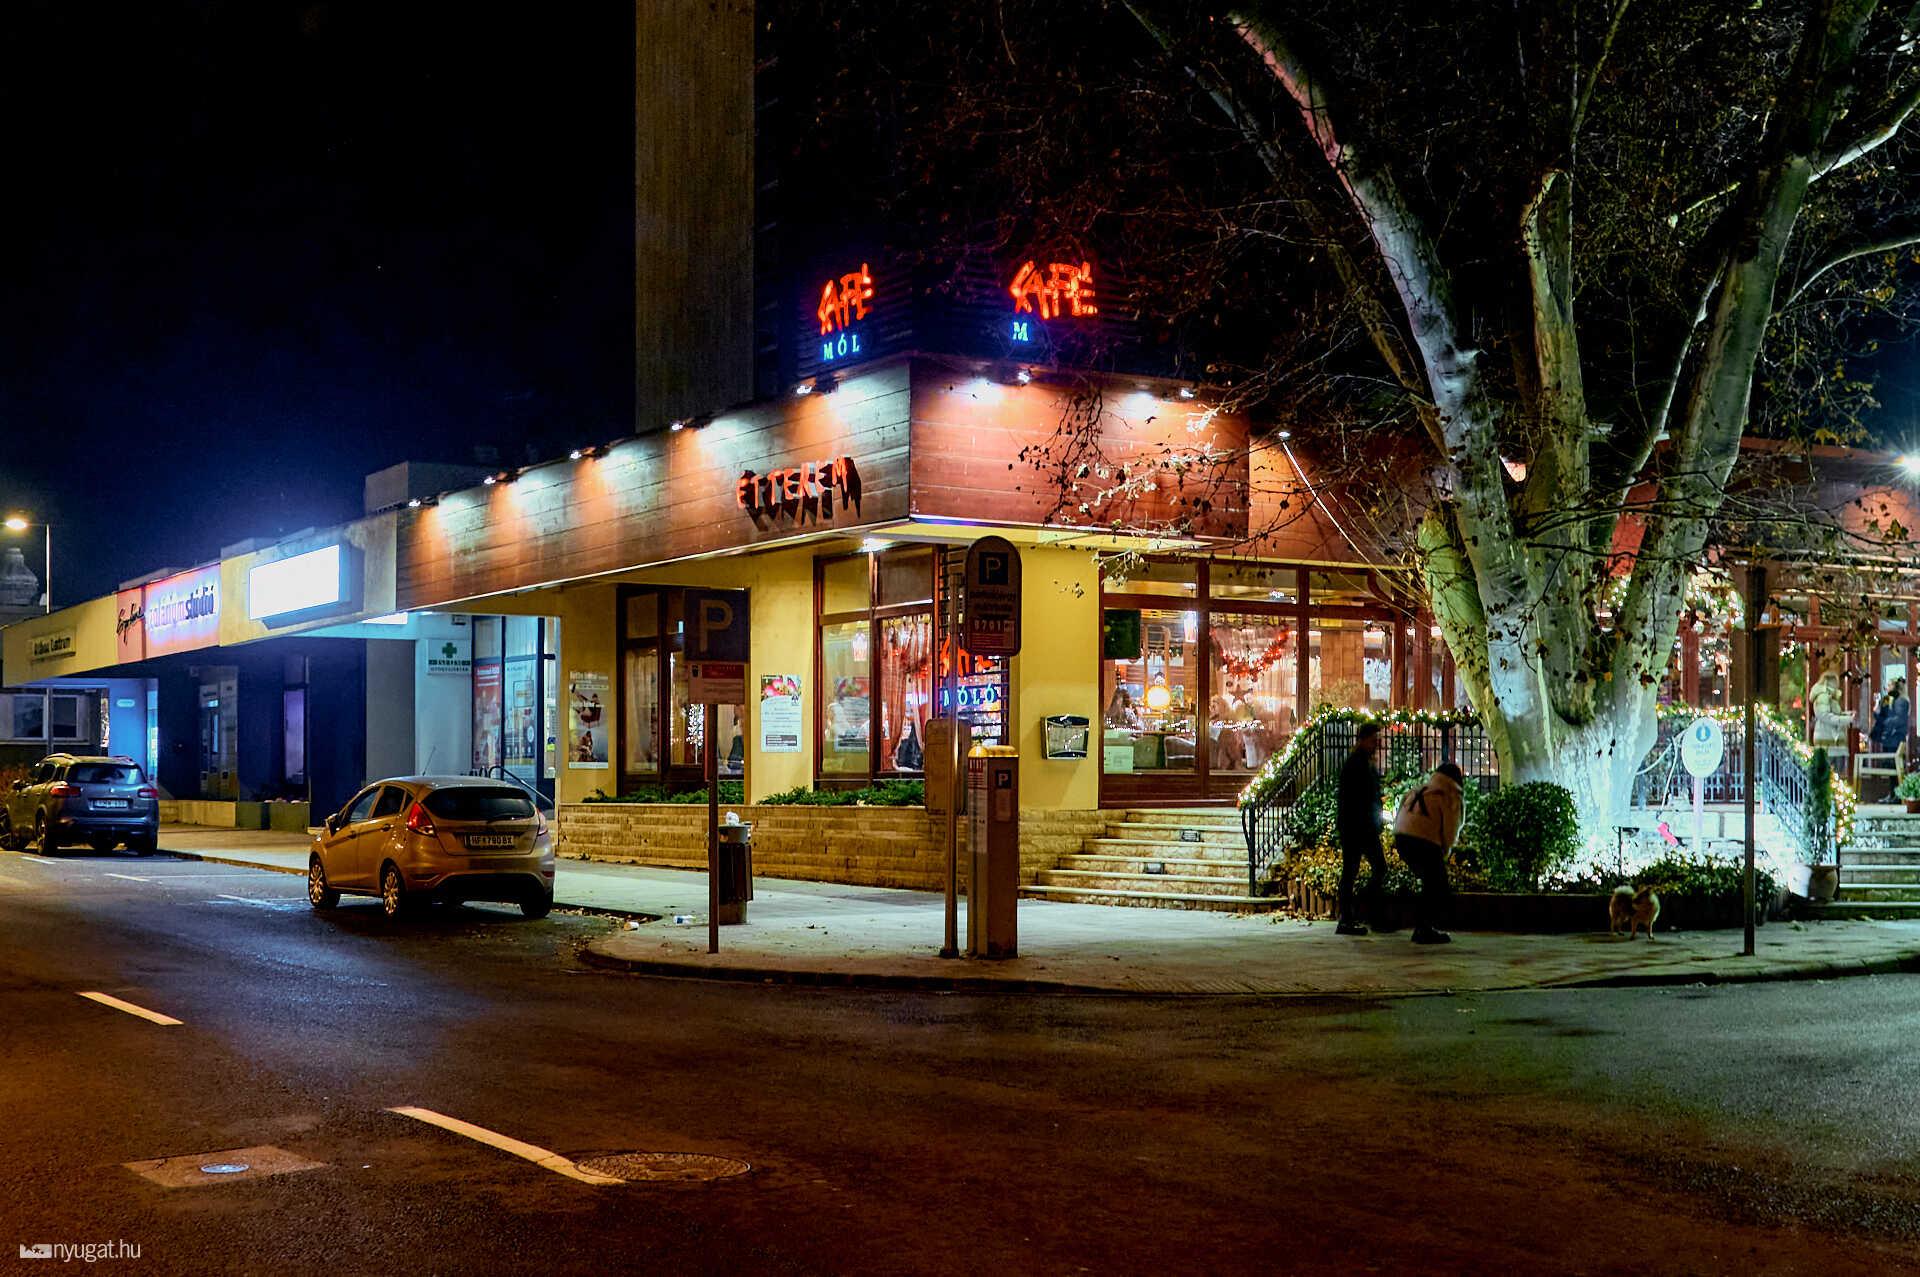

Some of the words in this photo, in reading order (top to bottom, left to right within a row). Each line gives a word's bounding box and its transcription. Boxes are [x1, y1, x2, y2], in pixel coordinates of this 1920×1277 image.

[818, 262, 873, 335] CAFÉ
[1010, 260, 1098, 320] CAFÉ
[736, 456, 848, 509] ÉTTEREM
[986, 557, 1001, 581] P
[699, 600, 733, 653] P
[998, 773, 1008, 787] P
